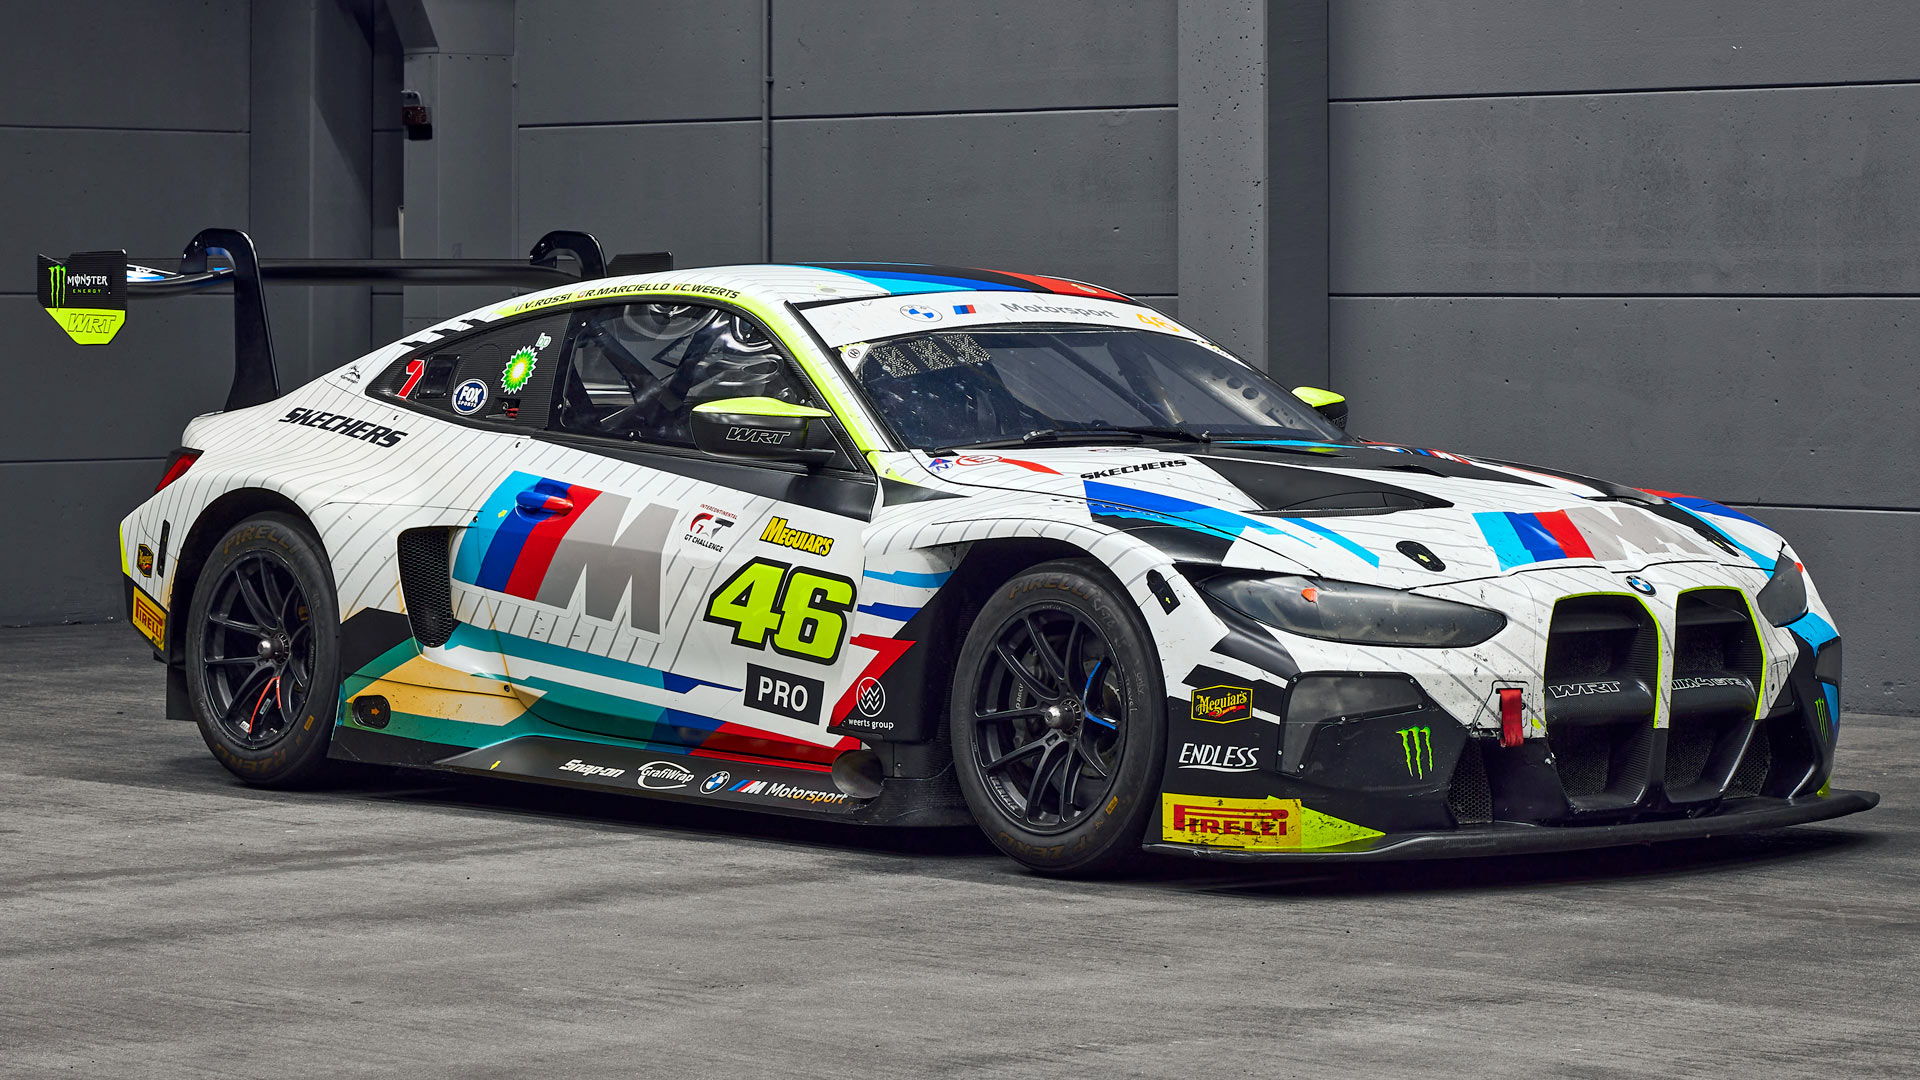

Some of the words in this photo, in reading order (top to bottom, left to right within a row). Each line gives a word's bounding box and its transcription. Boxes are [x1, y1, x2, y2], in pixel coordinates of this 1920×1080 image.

[67, 274, 108, 287] MONSTER
[67, 313, 116, 334] WRT
[1000, 302, 1120, 319] Motorsport
[1136, 313, 1180, 333] 46
[535, 333, 551, 350] bp
[460, 385, 482, 403] FOX
[278, 407, 408, 448] SKECHERS
[726, 427, 791, 444] WRT
[1080, 459, 1187, 479] SKECHERS
[684, 533, 693, 542] GT
[691, 536, 724, 553] CHALLENGE
[135, 597, 163, 641] PIRELLI
[703, 556, 857, 666] 46
[757, 676, 808, 712] PRO
[1548, 682, 1620, 699] WRT
[1195, 690, 1248, 717] Meguiar's
[848, 719, 870, 728] weerts
[871, 721, 895, 731] group
[1178, 742, 1260, 768] ENDLESS
[558, 758, 626, 778] Snap-on
[640, 766, 695, 784] GrafiWrap
[765, 783, 849, 805] Motorsport
[1173, 804, 1290, 836] PIRELLI
